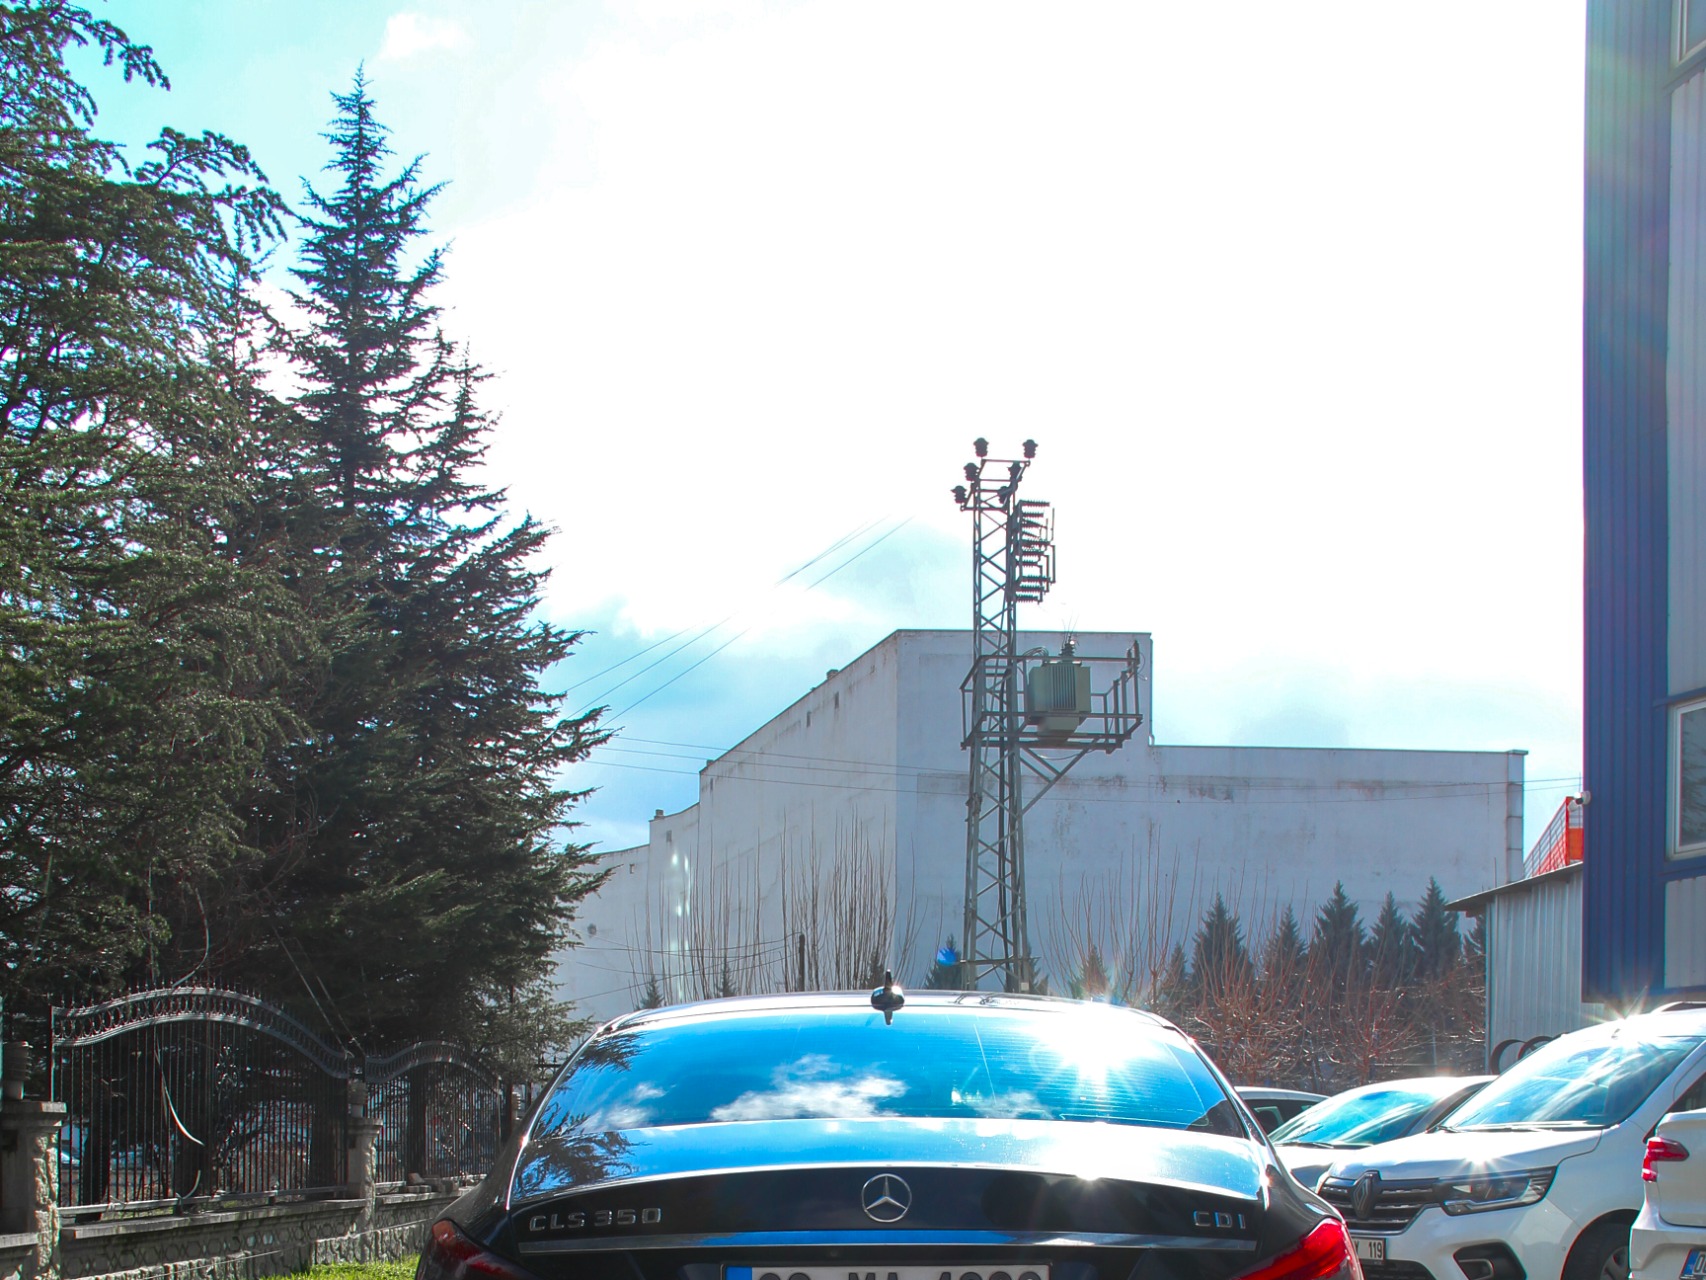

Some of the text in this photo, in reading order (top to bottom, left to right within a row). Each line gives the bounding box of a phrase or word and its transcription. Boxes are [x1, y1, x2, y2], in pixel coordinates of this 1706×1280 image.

[529, 1208, 661, 1232] CLS 350
[1193, 1210, 1246, 1229] CDI
[1369, 1241, 1383, 1258] 119
